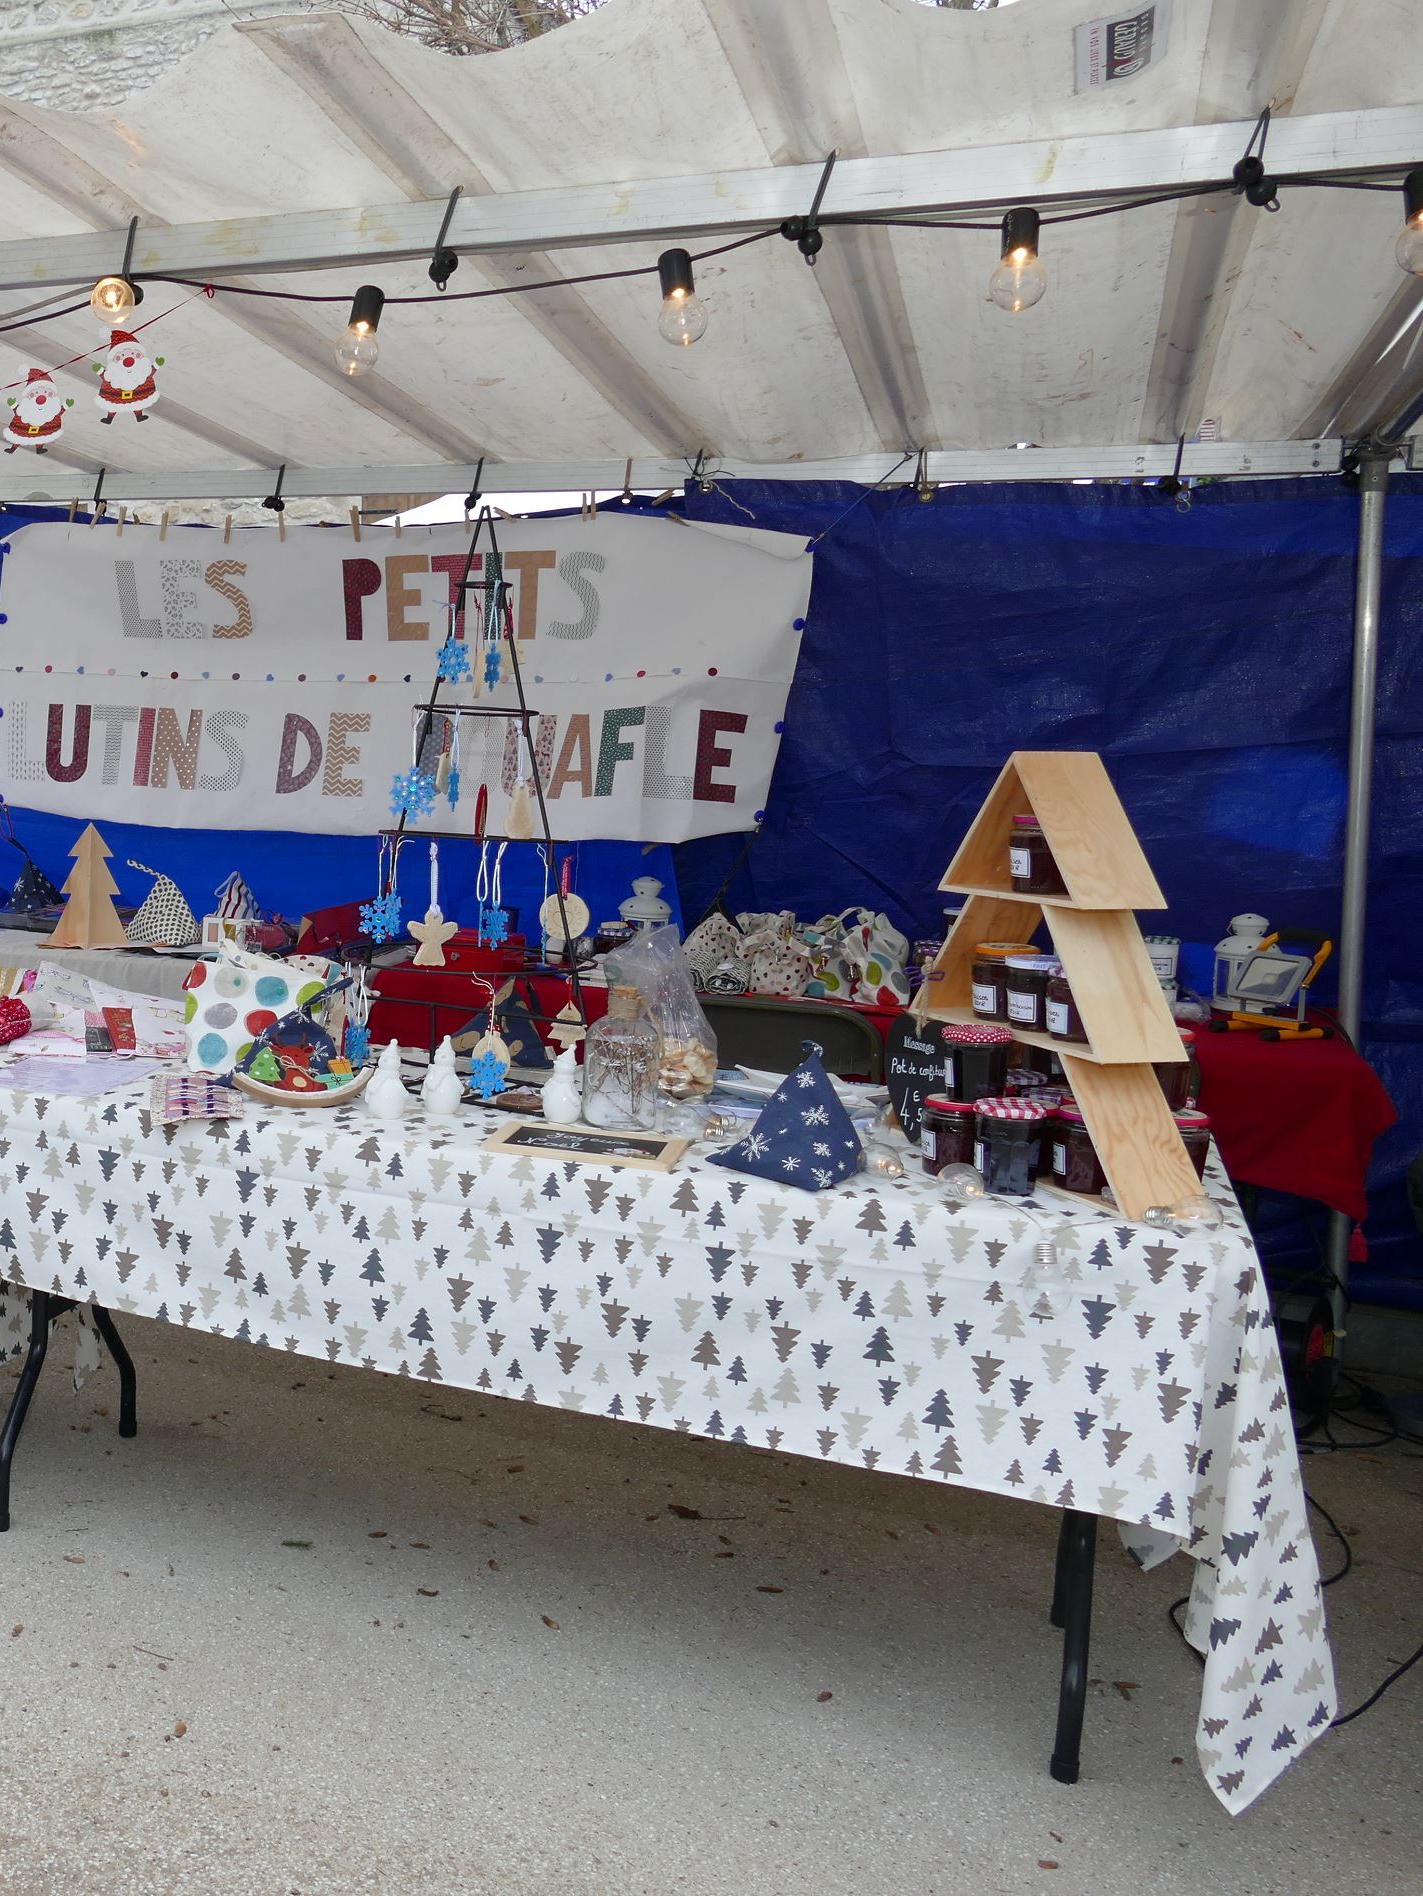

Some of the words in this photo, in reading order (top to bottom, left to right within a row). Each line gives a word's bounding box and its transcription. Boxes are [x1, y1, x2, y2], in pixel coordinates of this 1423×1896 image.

[114, 559, 253, 640] LES
[342, 550, 606, 641] PETITS
[6, 700, 250, 792] LUTINS
[275, 712, 371, 797] DE
[891, 1057, 907, 1074] Pot
[908, 1062, 917, 1075] de
